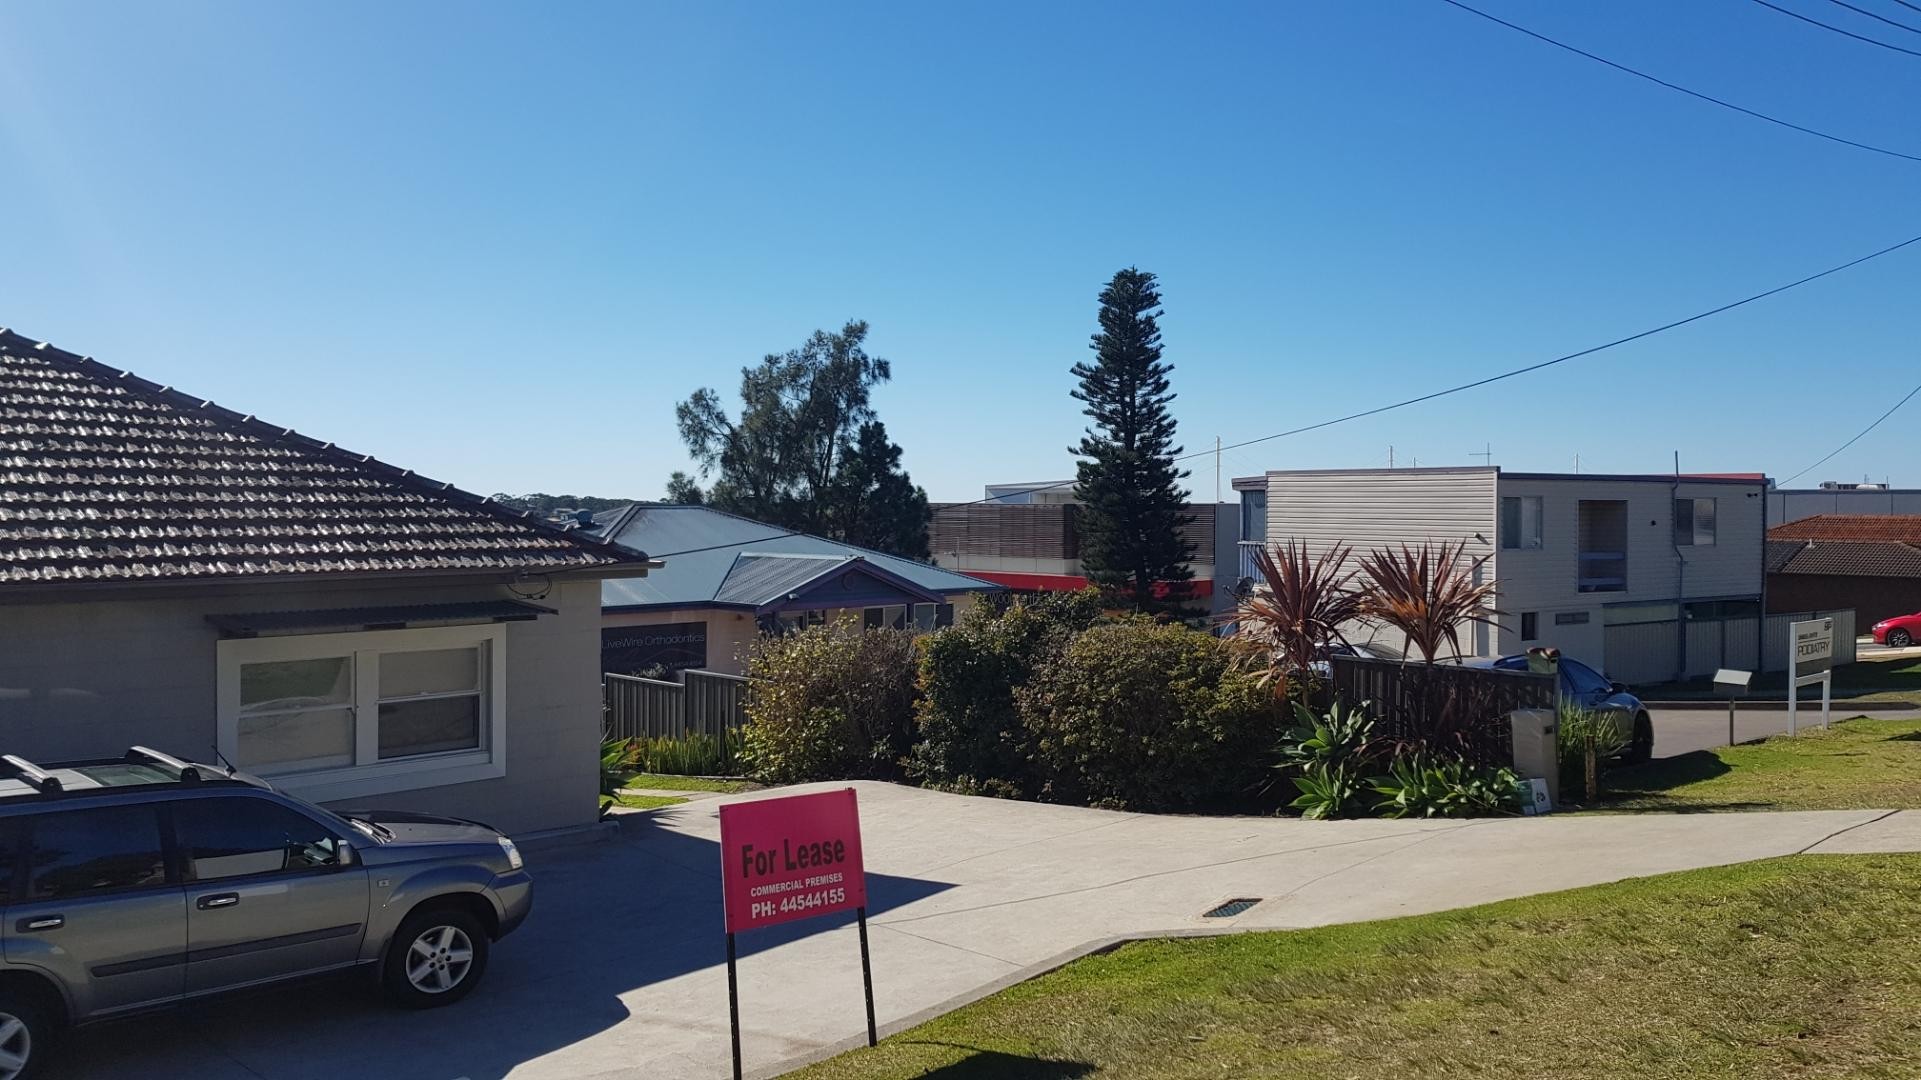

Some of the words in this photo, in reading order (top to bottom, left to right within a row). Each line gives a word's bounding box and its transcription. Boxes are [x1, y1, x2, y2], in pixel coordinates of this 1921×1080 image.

[601, 637, 643, 649] LiveWire
[645, 633, 705, 646] Orthodontics
[1797, 641, 1830, 656] PODIATRY
[742, 844, 776, 878] For
[784, 839, 845, 871] Lease
[751, 879, 804, 897] COMMERCIAL
[805, 872, 843, 888] PREMISES
[751, 901, 776, 919] PH:
[780, 888, 845, 913] 44544155
